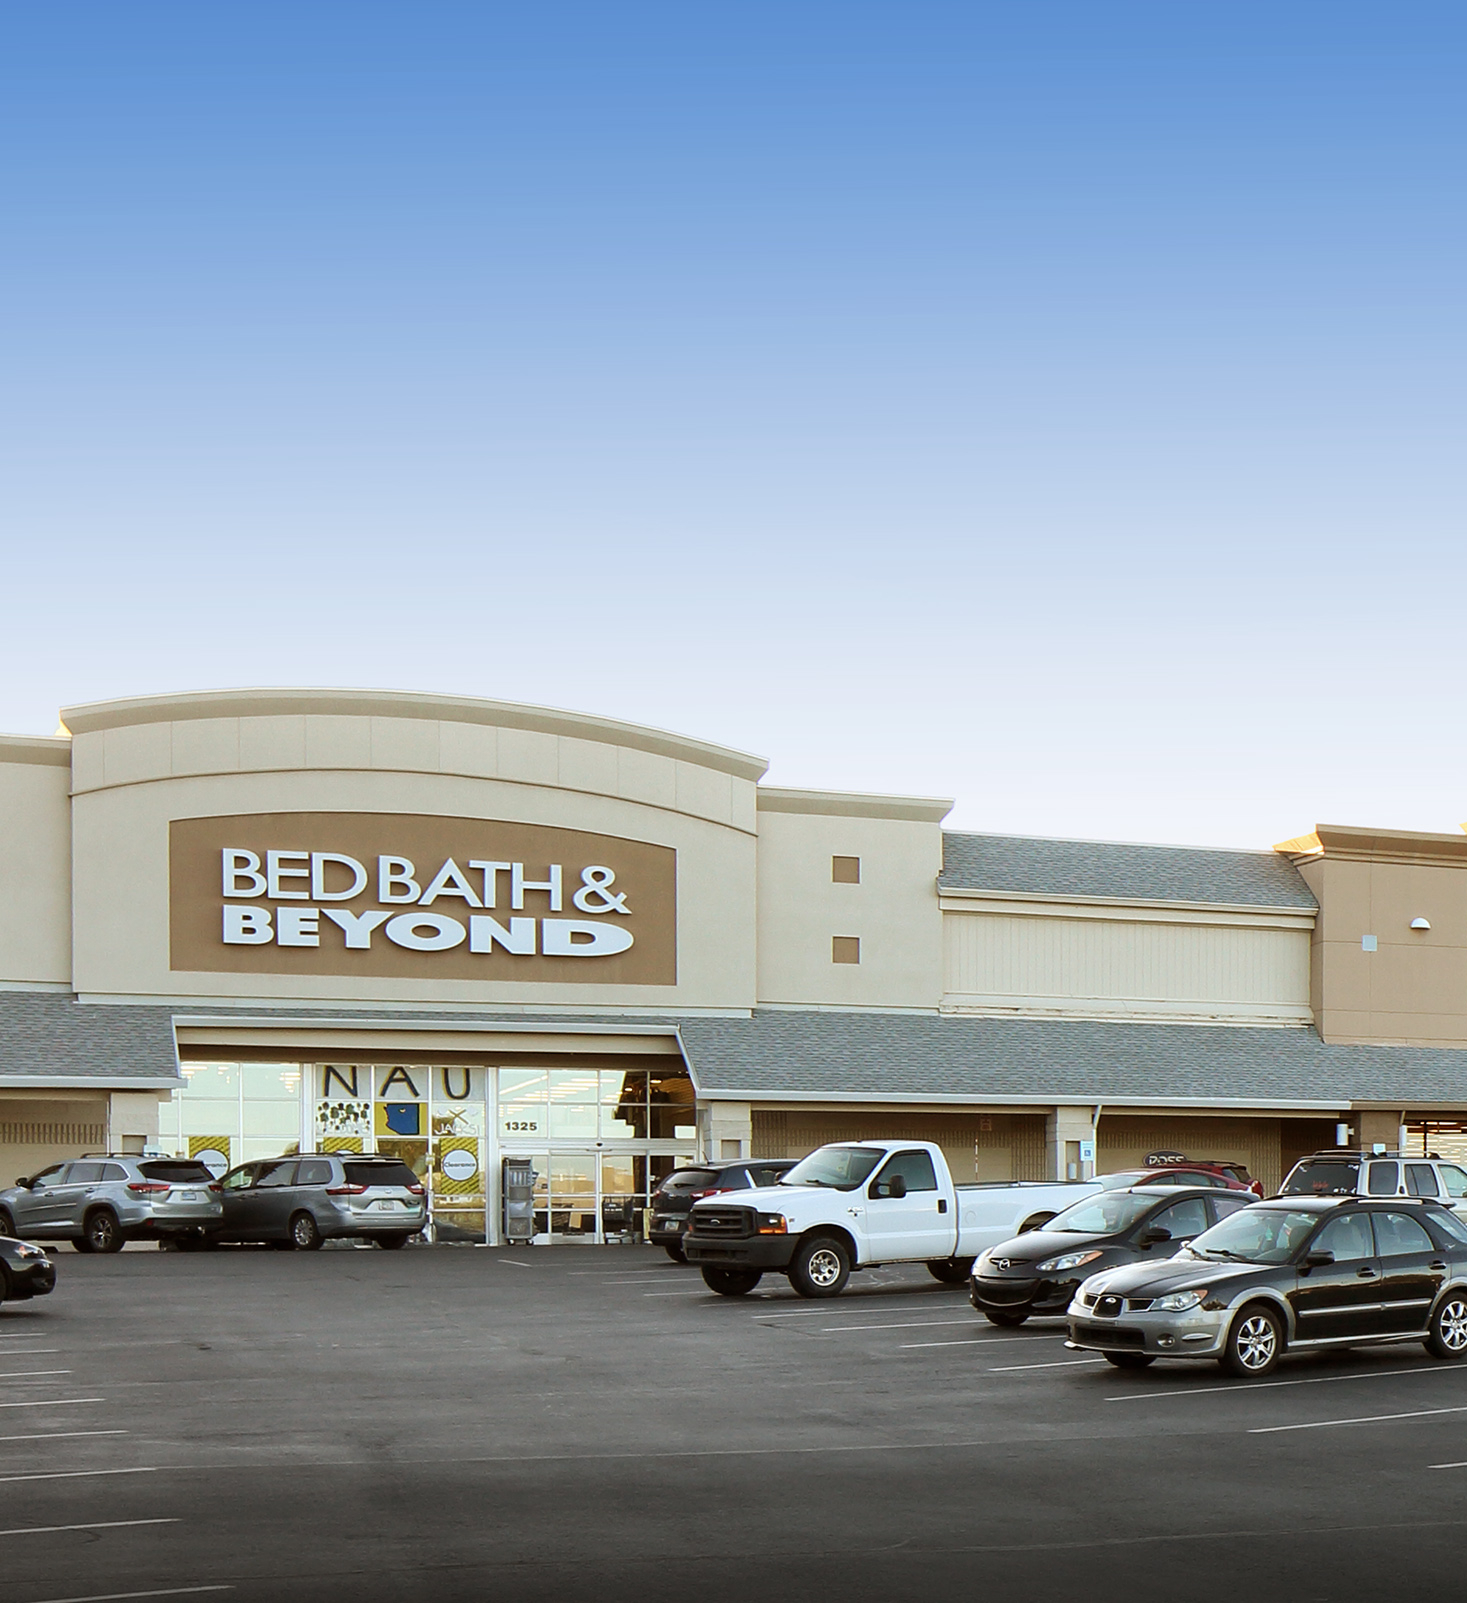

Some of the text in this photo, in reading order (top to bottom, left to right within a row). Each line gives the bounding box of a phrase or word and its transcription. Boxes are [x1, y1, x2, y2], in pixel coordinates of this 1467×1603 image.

[222, 848, 632, 915] BED BATH &
[222, 904, 634, 957] BEYOND
[505, 1122, 537, 1131] 1325
